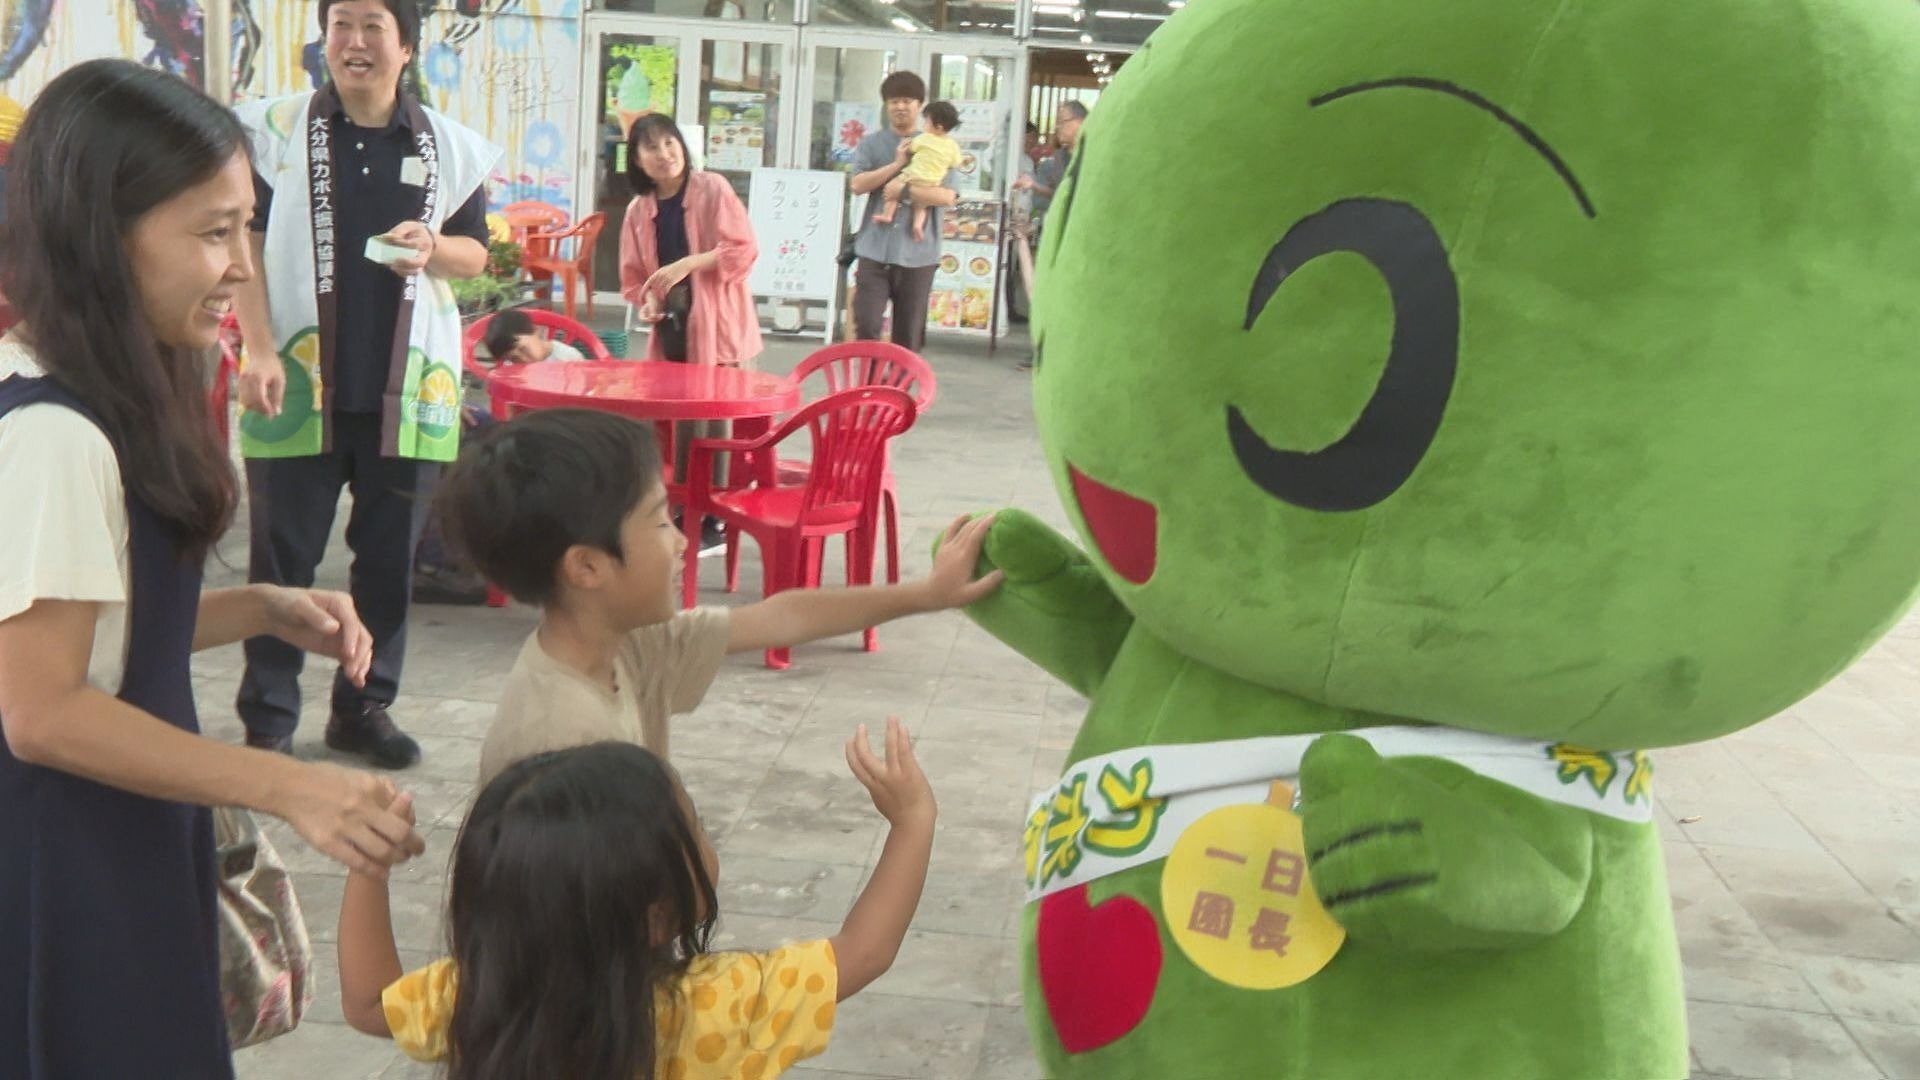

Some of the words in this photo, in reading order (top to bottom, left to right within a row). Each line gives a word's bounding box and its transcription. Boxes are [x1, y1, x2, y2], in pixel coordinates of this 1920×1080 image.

[771, 179, 786, 220] カフェ
[804, 181, 821, 237] ショップ
[1205, 848, 1304, 897] 一日
